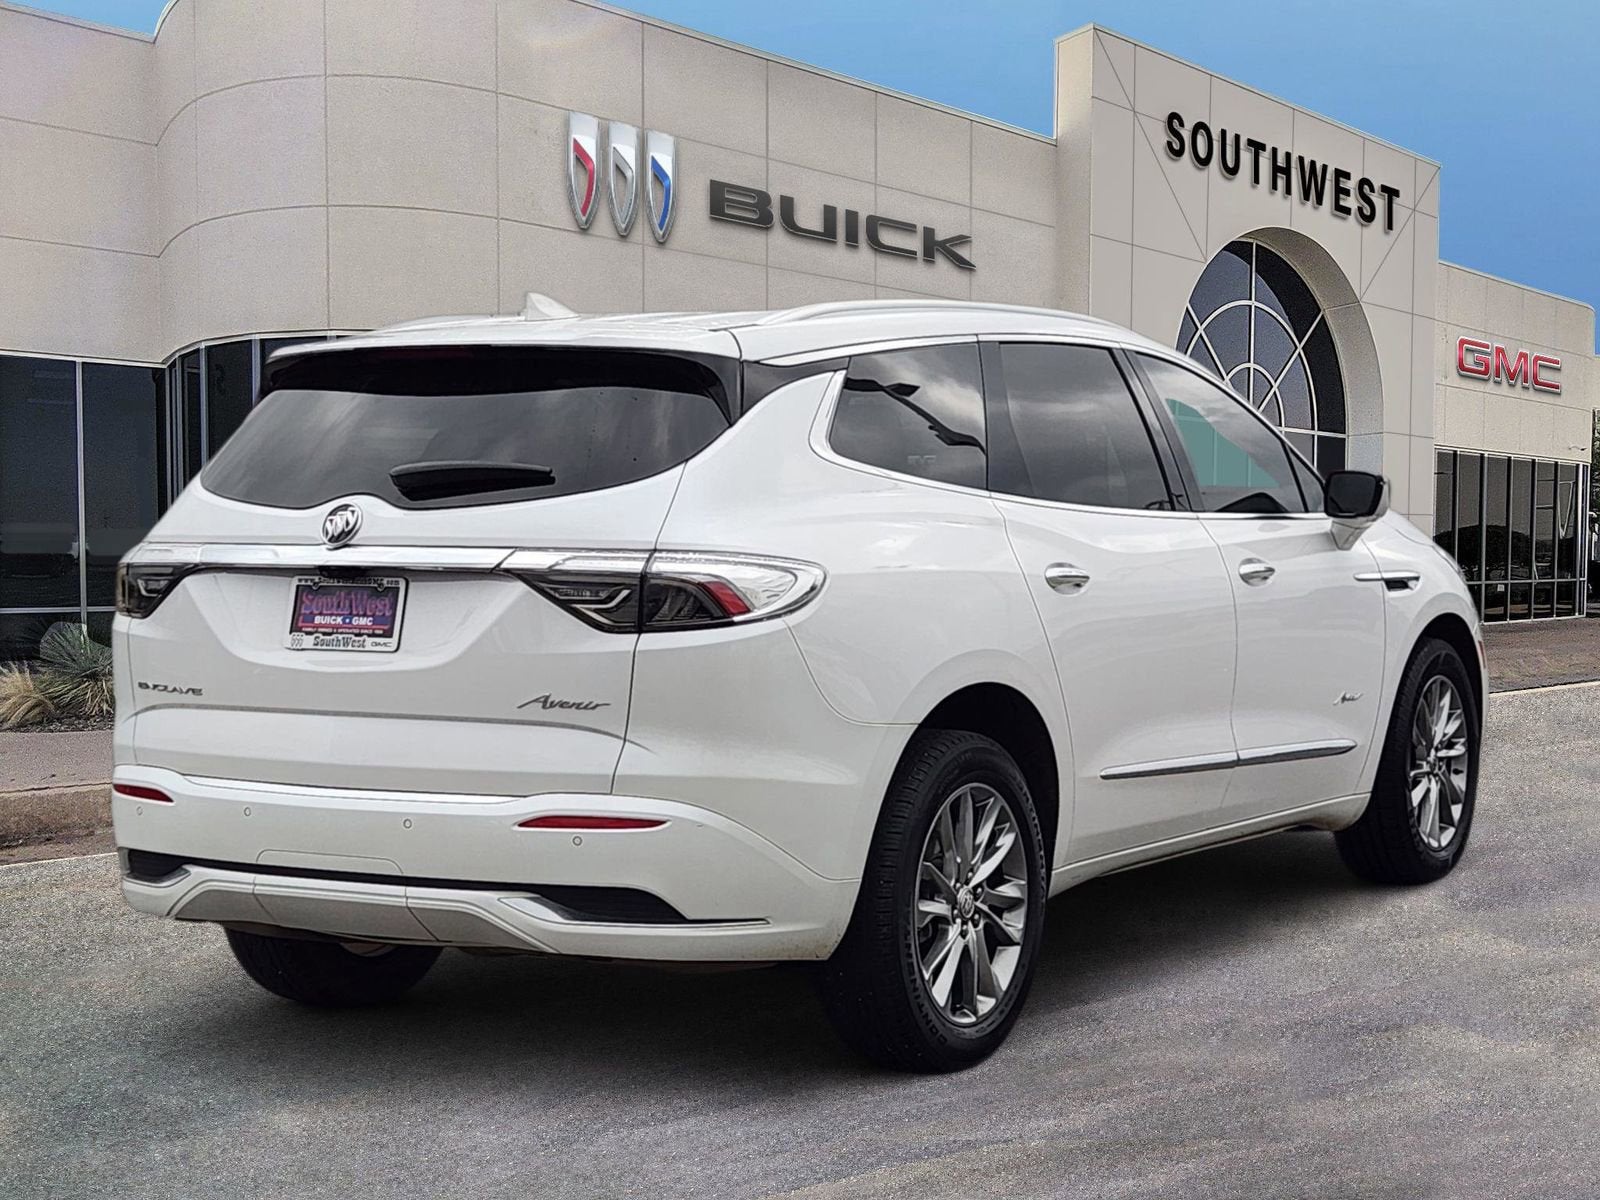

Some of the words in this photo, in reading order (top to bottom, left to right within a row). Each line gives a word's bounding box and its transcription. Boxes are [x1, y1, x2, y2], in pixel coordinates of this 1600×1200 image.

[1165, 111, 1401, 231] SOUTHWEST
[709, 178, 977, 271] BUICK
[1456, 335, 1562, 394] GMC
[314, 615, 344, 625] BUICK
[352, 616, 374, 626] GMC
[312, 635, 367, 648] SouthWest
[516, 693, 611, 710] Avenir
